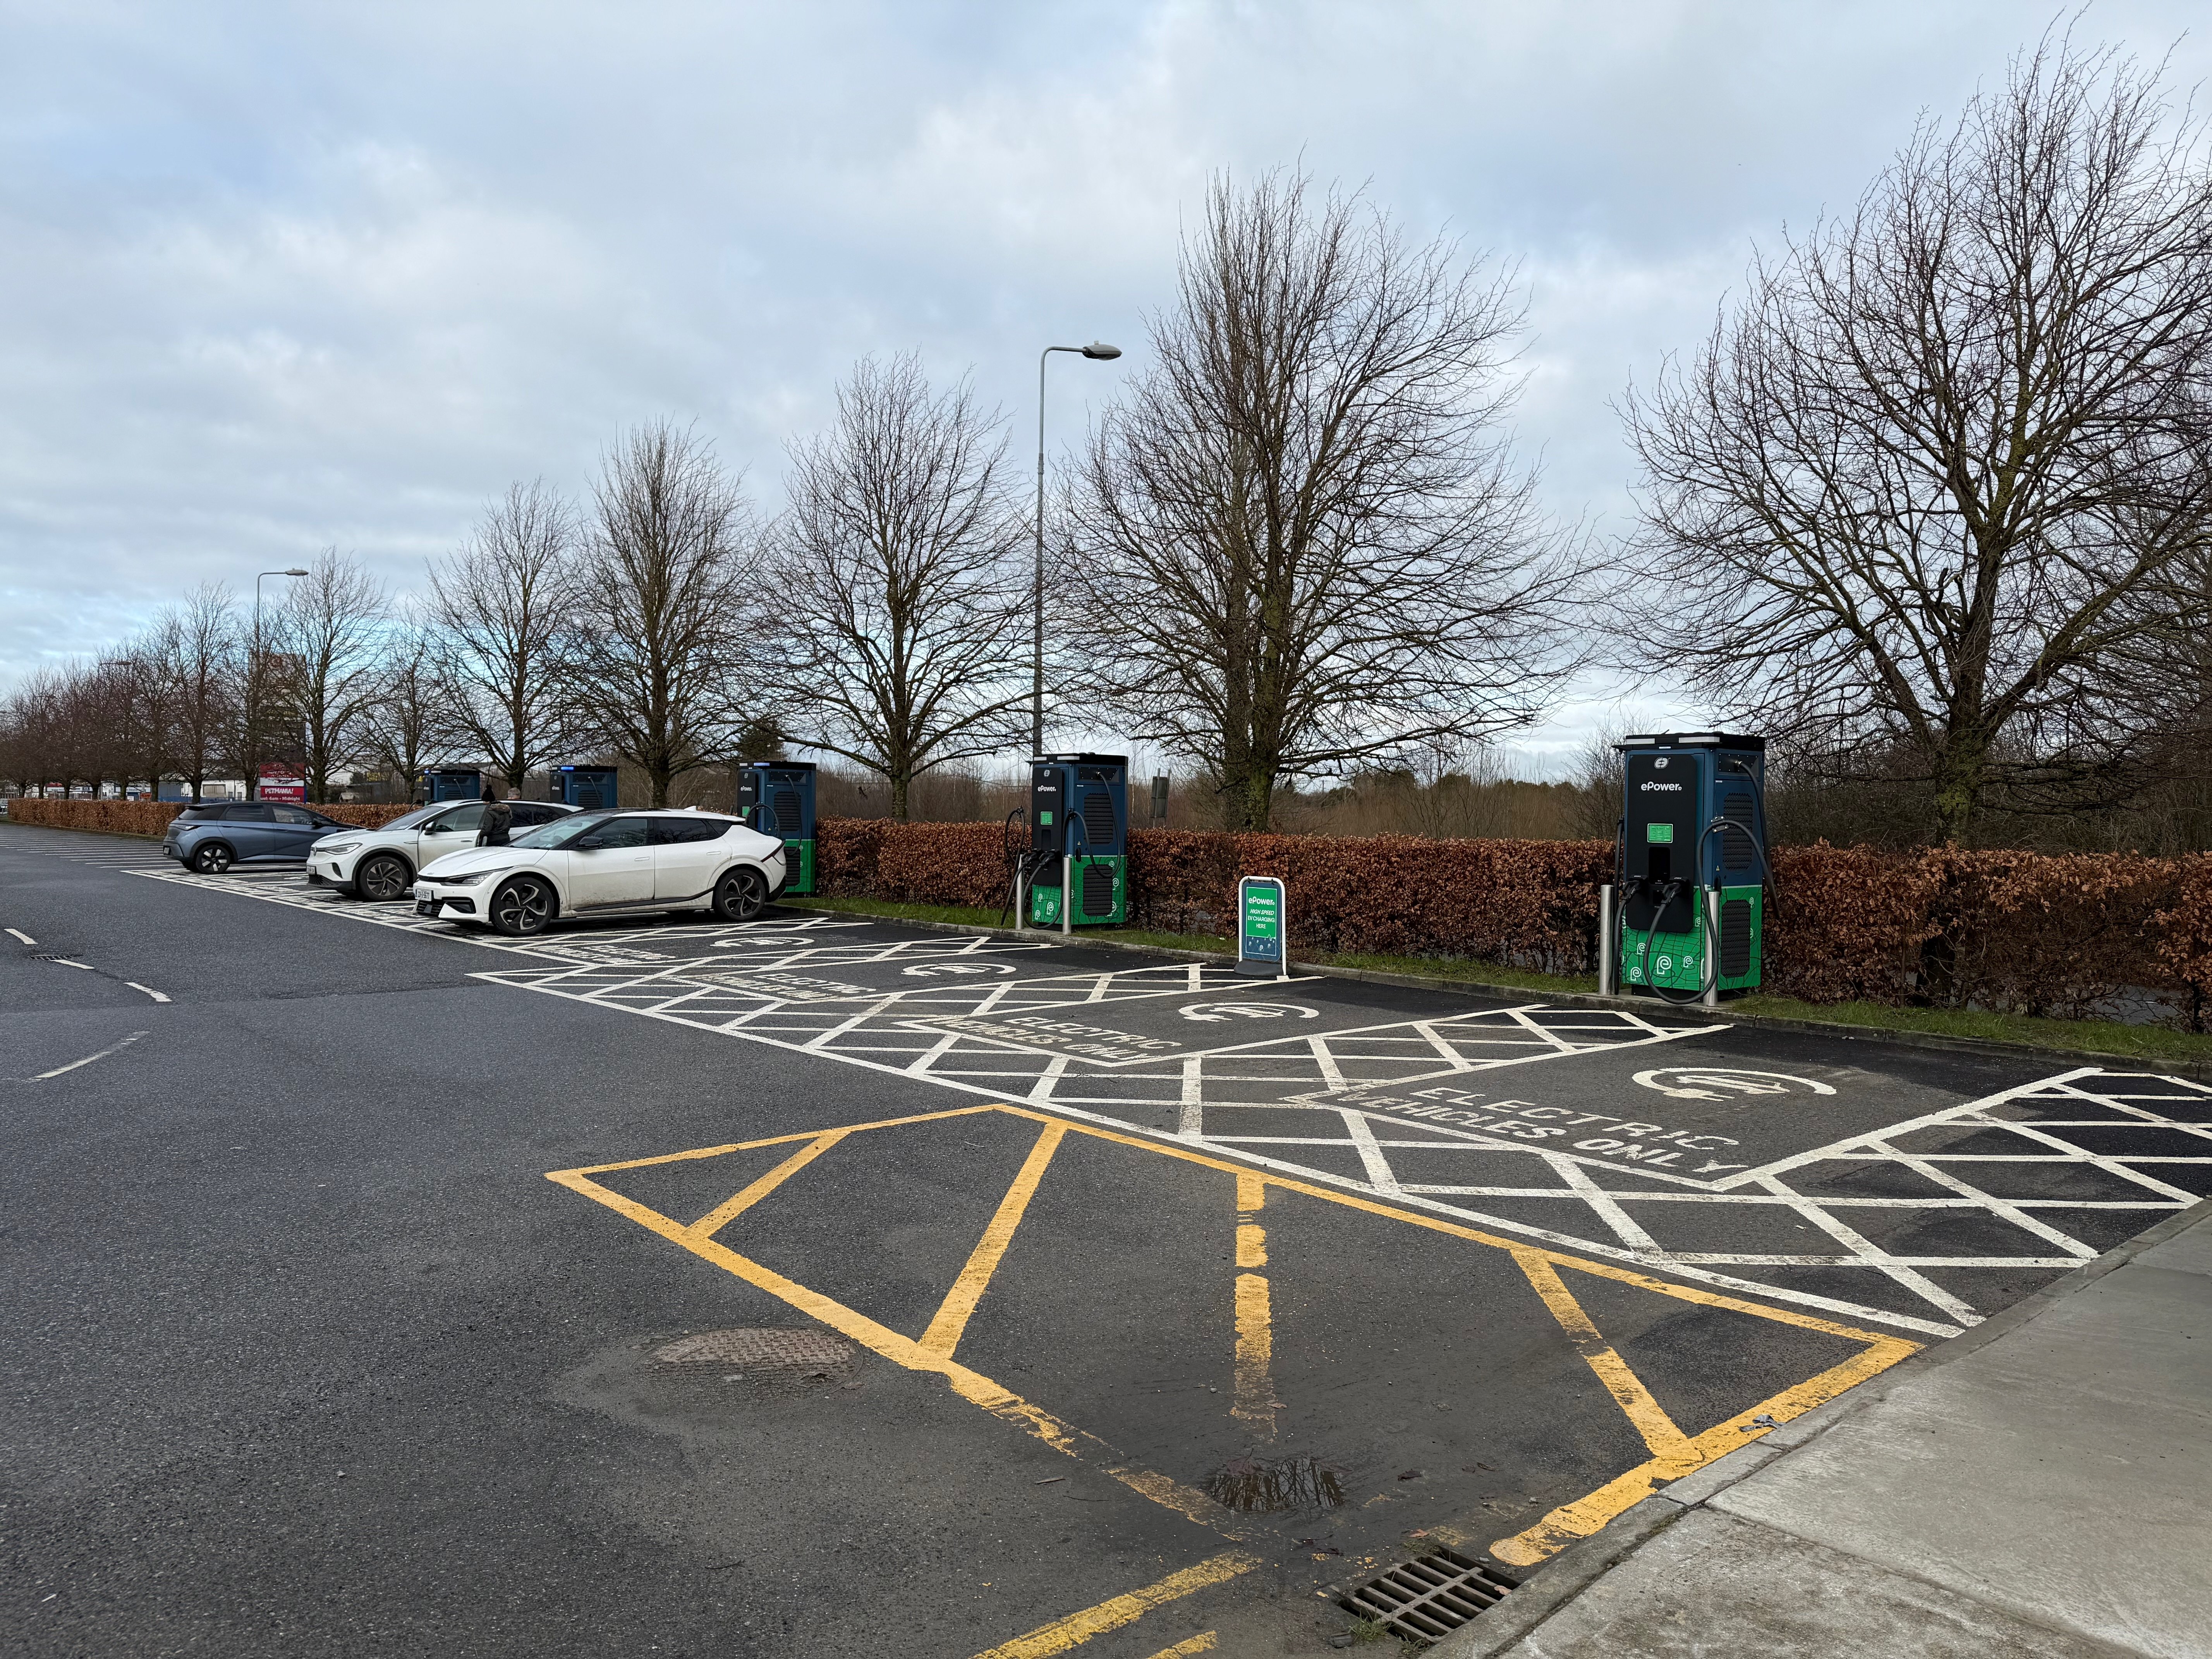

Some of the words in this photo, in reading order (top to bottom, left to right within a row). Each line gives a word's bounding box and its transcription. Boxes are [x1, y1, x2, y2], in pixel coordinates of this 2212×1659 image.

[1641, 781, 1680, 791] ePower
[1249, 896, 1273, 905] ePower
[753, 973, 876, 993] ELECTRIC
[933, 1018, 1072, 1044] VEHICLES
[1063, 1044, 1161, 1060] ONLY
[1002, 1017, 1182, 1049] ELECTRIC
[1337, 1091, 1567, 1139] VEHICLES
[1573, 1139, 1749, 1173] ONLY
[1410, 1087, 1740, 1150] ELECTRIC
